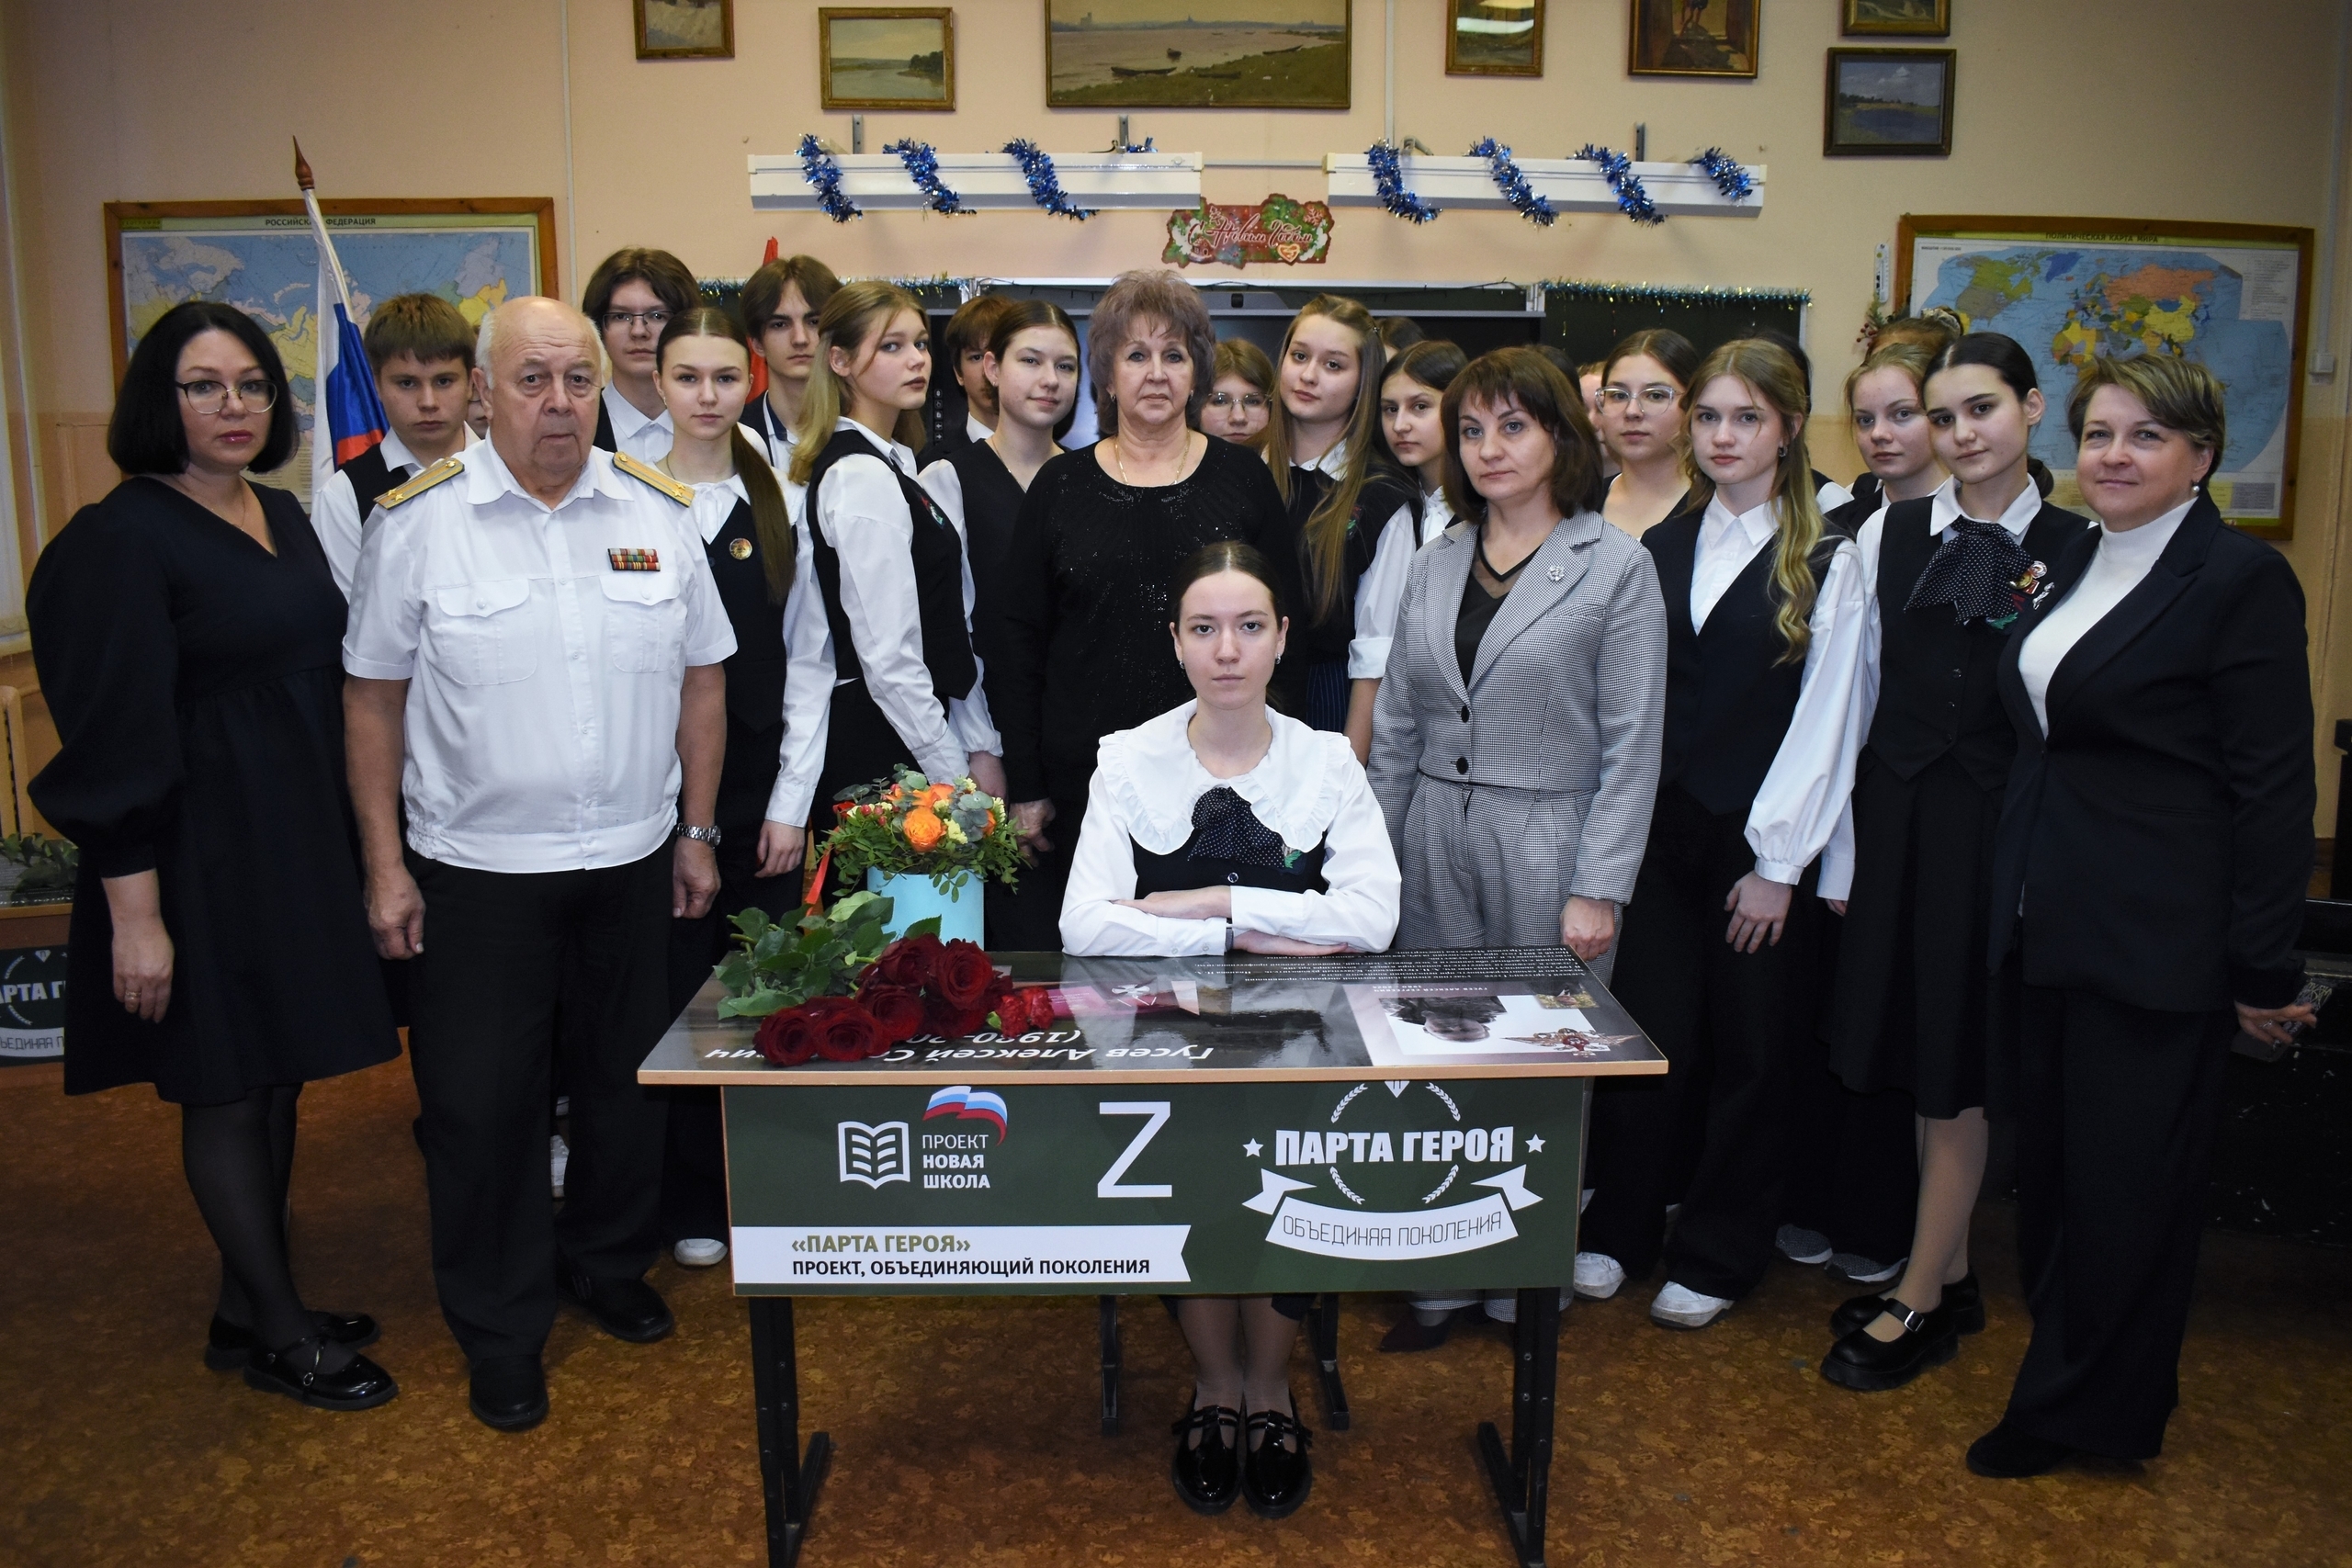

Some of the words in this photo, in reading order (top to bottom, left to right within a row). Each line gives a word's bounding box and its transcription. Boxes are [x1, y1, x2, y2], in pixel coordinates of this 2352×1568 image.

[265, 218, 312, 227] РОССИЙСК
[325, 218, 376, 227] ФЕДЕРАЦИЯ
[2045, 231, 2107, 242] ПОЛИТИЧЕСКАЯ
[2109, 234, 2133, 243] КАРТА
[2136, 235, 2158, 243] МИРА
[0, 982, 48, 1005] РТА
[0, 1037, 53, 1050] ЪЕДИНЯЯ
[925, 1047, 1098, 1062] Алексей
[1105, 1044, 1214, 1059] Гусев
[922, 1134, 989, 1149] ПРОЕКТ
[1275, 1129, 1395, 1166] ПАРТА
[1402, 1126, 1514, 1163] ГЕРОЯ
[1097, 1100, 1173, 1199] Z
[922, 1154, 985, 1169] НОВАЯ
[923, 1174, 991, 1190] ШКОЛА
[1283, 1214, 1392, 1247] ОБЪЕДИНЯЯ
[1397, 1211, 1502, 1247] ПОКОЛЕНИЯ
[792, 1260, 865, 1278] ПРОЕКТ,
[870, 1257, 1034, 1279] ОБЪЕДИНЯЮЩИЙ
[1039, 1259, 1150, 1275] ПОКОЛЕНИЯ
